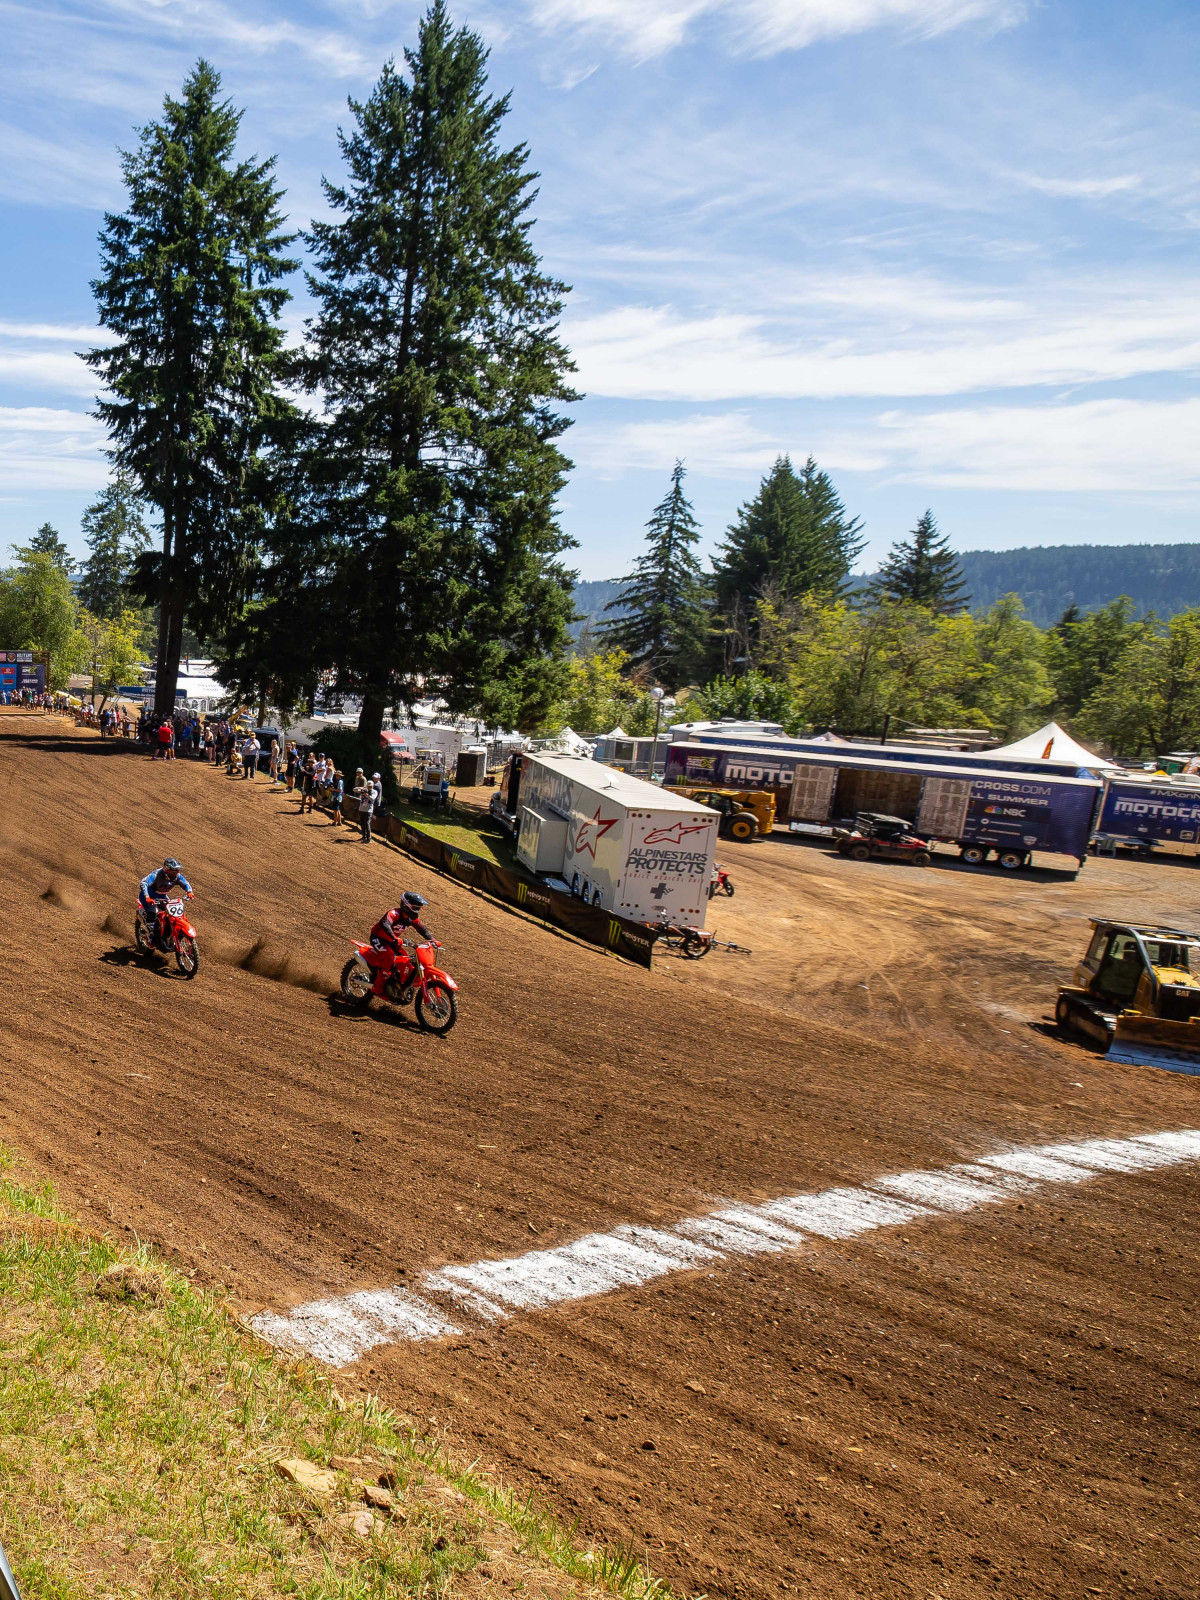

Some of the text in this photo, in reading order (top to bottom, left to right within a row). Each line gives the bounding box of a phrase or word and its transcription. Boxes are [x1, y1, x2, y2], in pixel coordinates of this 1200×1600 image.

[987, 793, 1049, 806] SUMMER
[1002, 807, 1027, 818] NBC
[629, 847, 708, 863] ALPINESTARS
[625, 856, 707, 875] PROTECTS
[170, 906, 184, 916] 96
[1175, 989, 1191, 997] CAT
